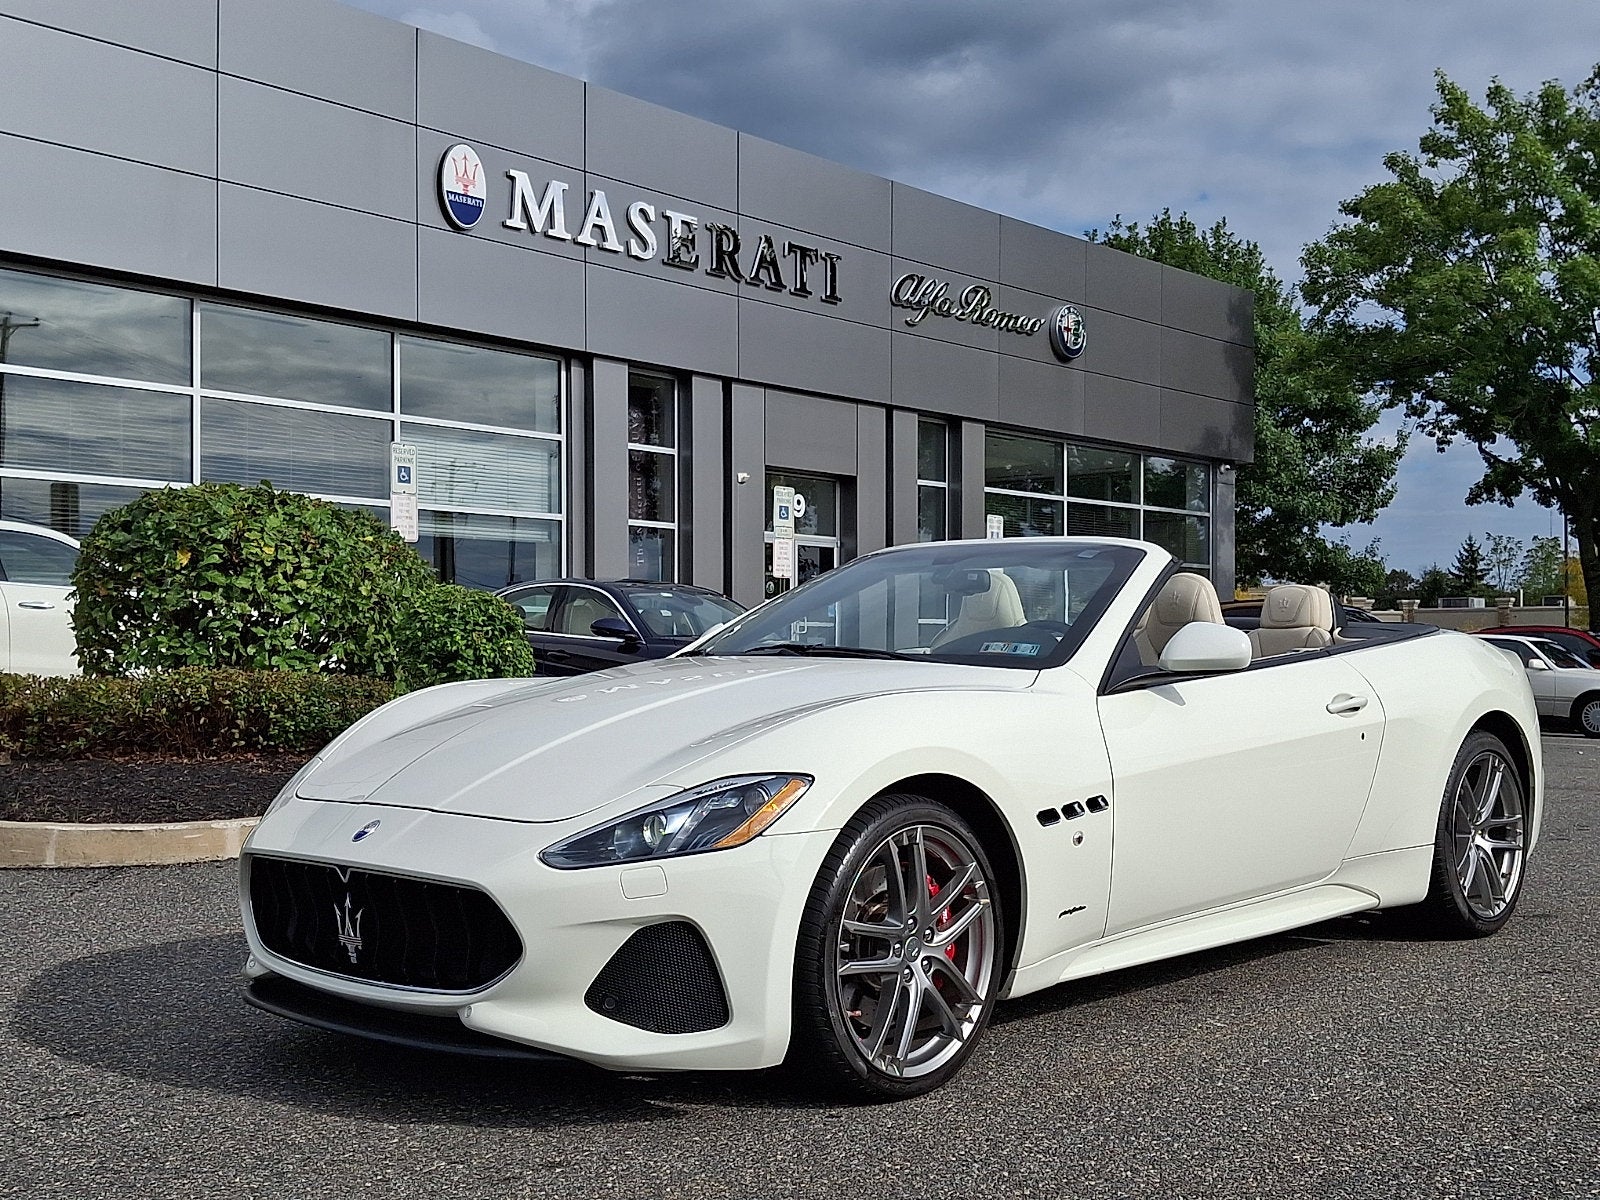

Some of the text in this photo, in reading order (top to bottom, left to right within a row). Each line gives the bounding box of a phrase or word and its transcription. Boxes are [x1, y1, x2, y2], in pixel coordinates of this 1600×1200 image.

[447, 191, 483, 208] MASERATI
[503, 168, 842, 304] MASERATI
[889, 273, 1045, 336] Alfa Romeo
[793, 493, 806, 518] 9
